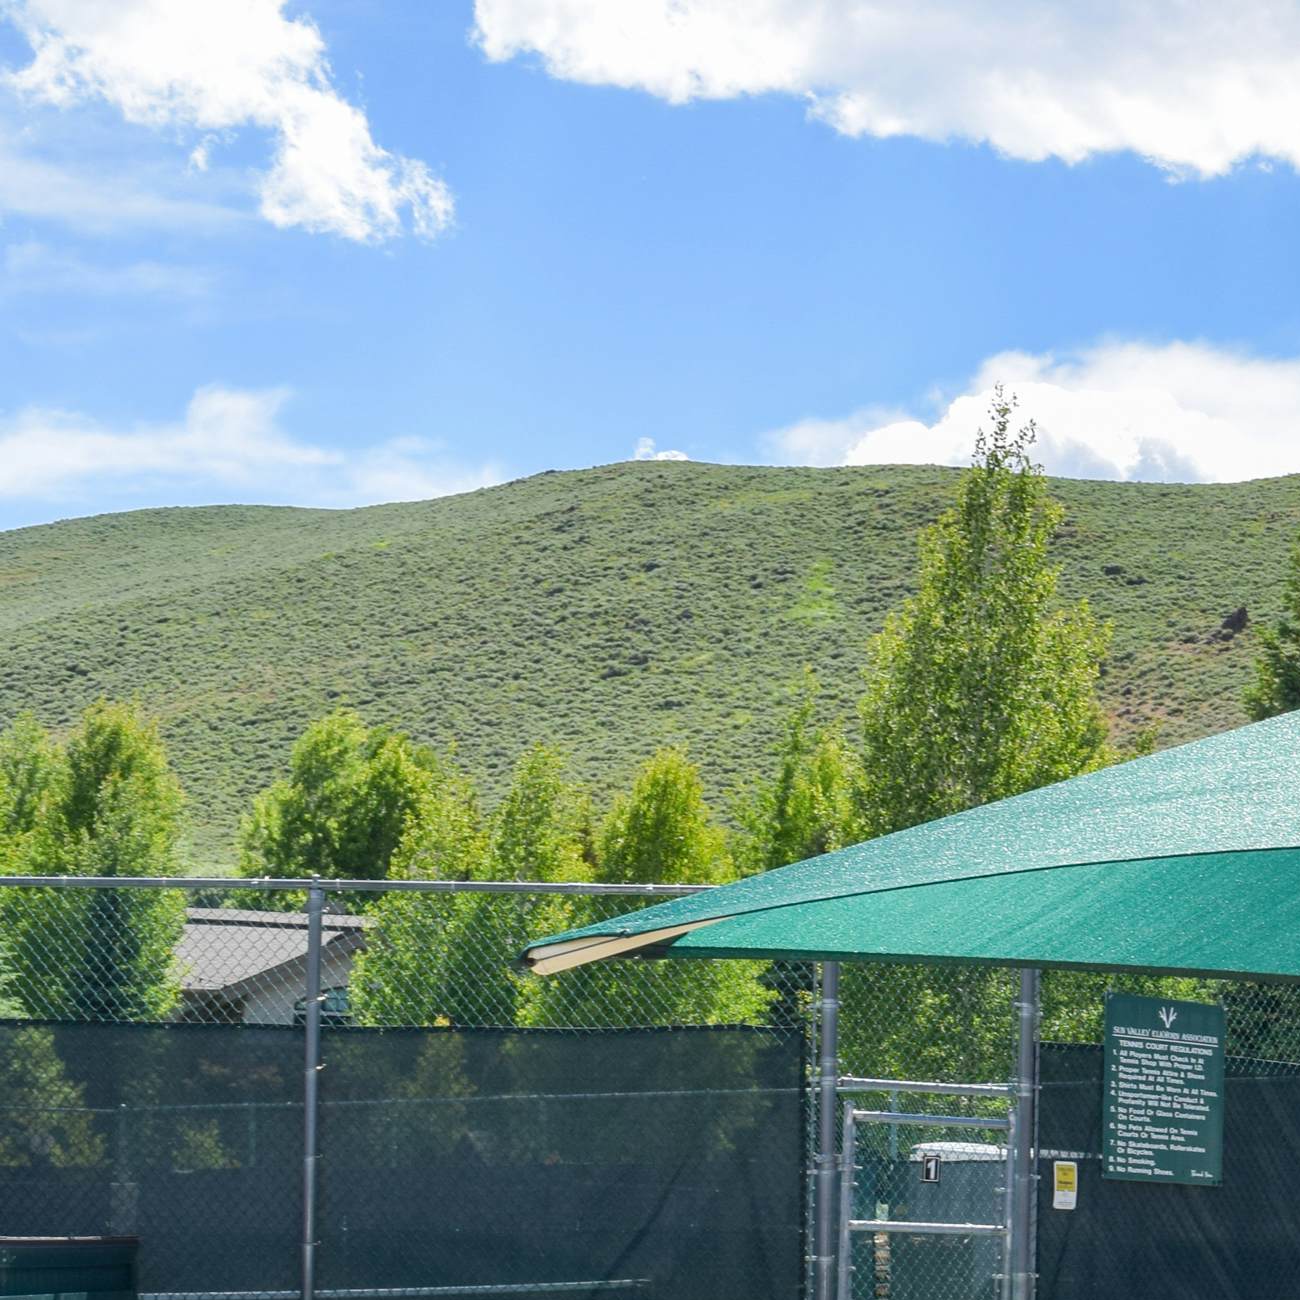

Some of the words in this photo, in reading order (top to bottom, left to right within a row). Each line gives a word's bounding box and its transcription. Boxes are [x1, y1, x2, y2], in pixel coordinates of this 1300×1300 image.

[1127, 1027, 1150, 1036] VALLEY
[1119, 1040, 1144, 1048] TENNIS
[1146, 1042, 1168, 1050] COURT
[1170, 1045, 1213, 1056] REGULATIONS
[1129, 1051, 1152, 1059] Players
[1118, 1065, 1139, 1073] Proper
[1142, 1067, 1160, 1075] Tennis
[1174, 1062, 1193, 1070] Proper
[1118, 1072, 1146, 1081] Required
[1174, 1095, 1198, 1103] Conduct
[1175, 1112, 1206, 1120] Containers
[1144, 1125, 1168, 1133] Allowed
[1117, 1130, 1139, 1138] Courts
[927, 1159, 936, 1180] 1
